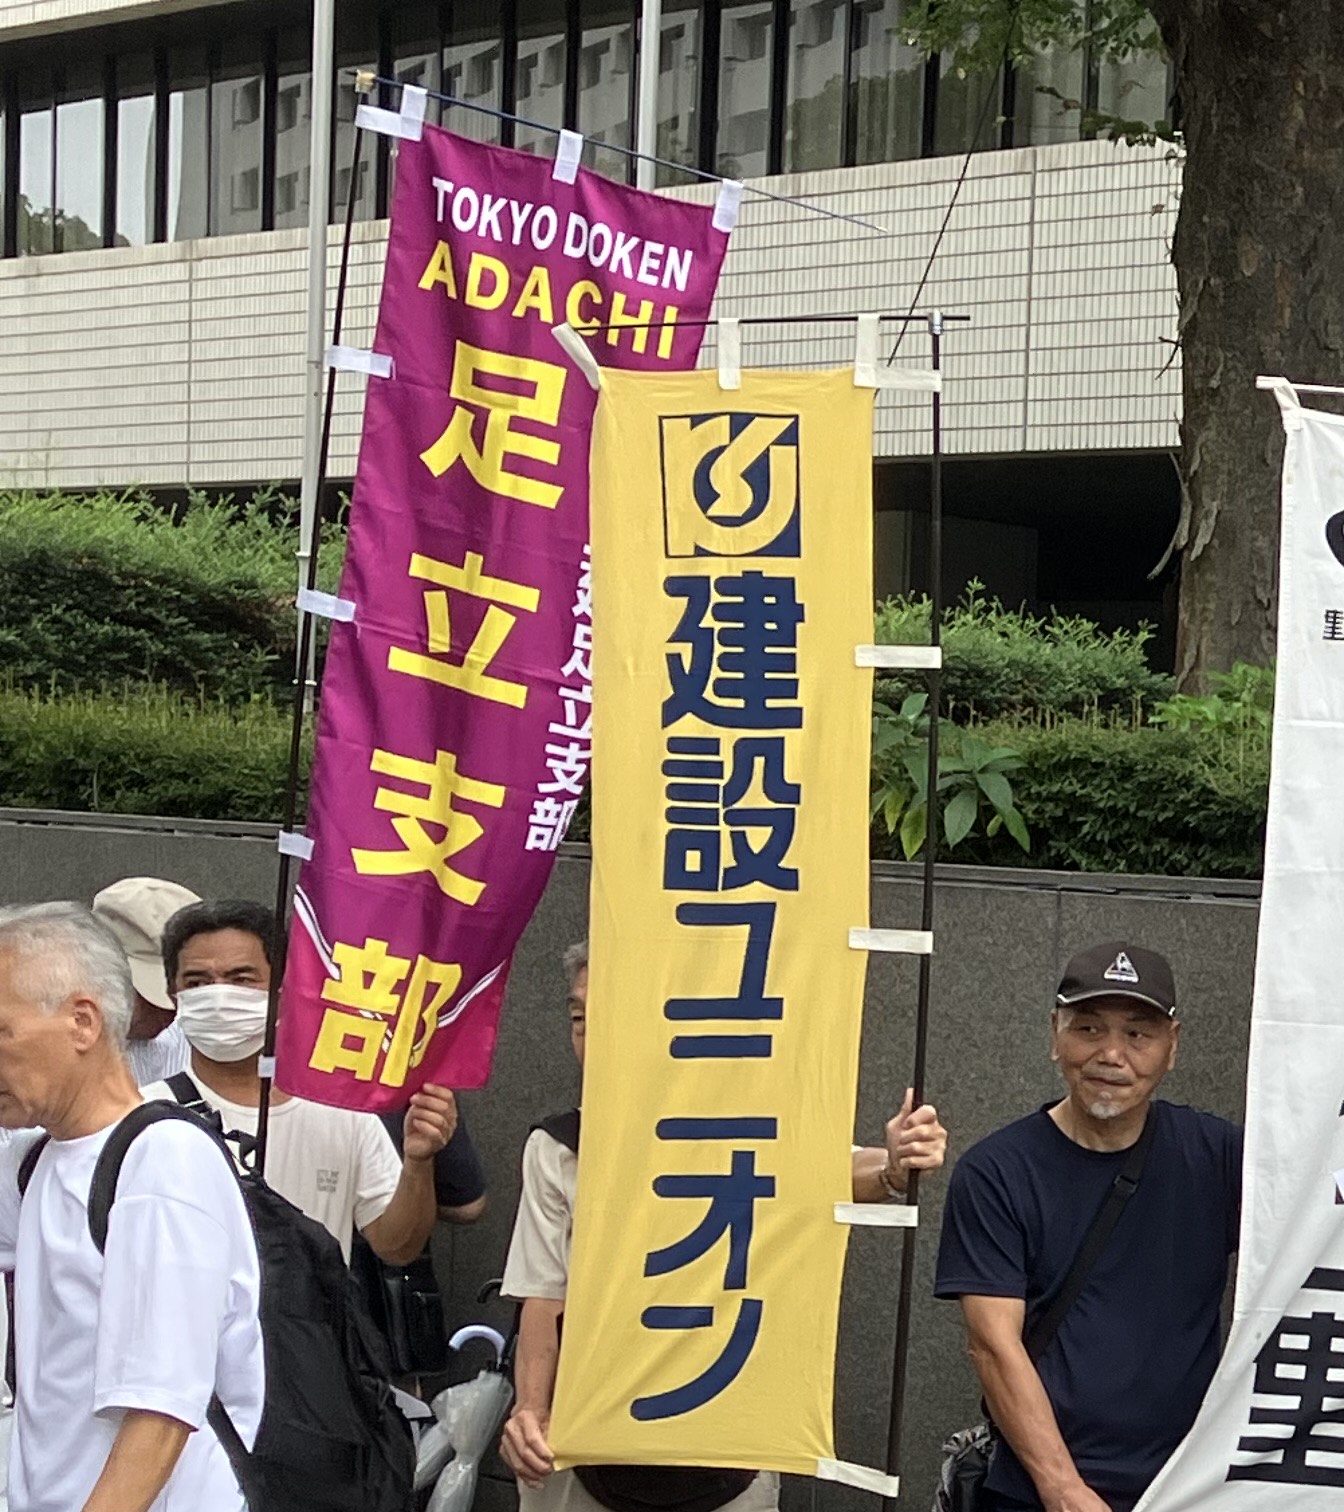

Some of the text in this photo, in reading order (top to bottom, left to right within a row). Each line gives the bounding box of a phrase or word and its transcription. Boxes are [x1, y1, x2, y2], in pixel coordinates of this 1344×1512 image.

[418, 241, 679, 360] ADACHI
[432, 176, 693, 292] TOKYO DOKEN
[308, 339, 567, 1088] 足立支部
[630, 570, 806, 1421] 建設ユニオン
